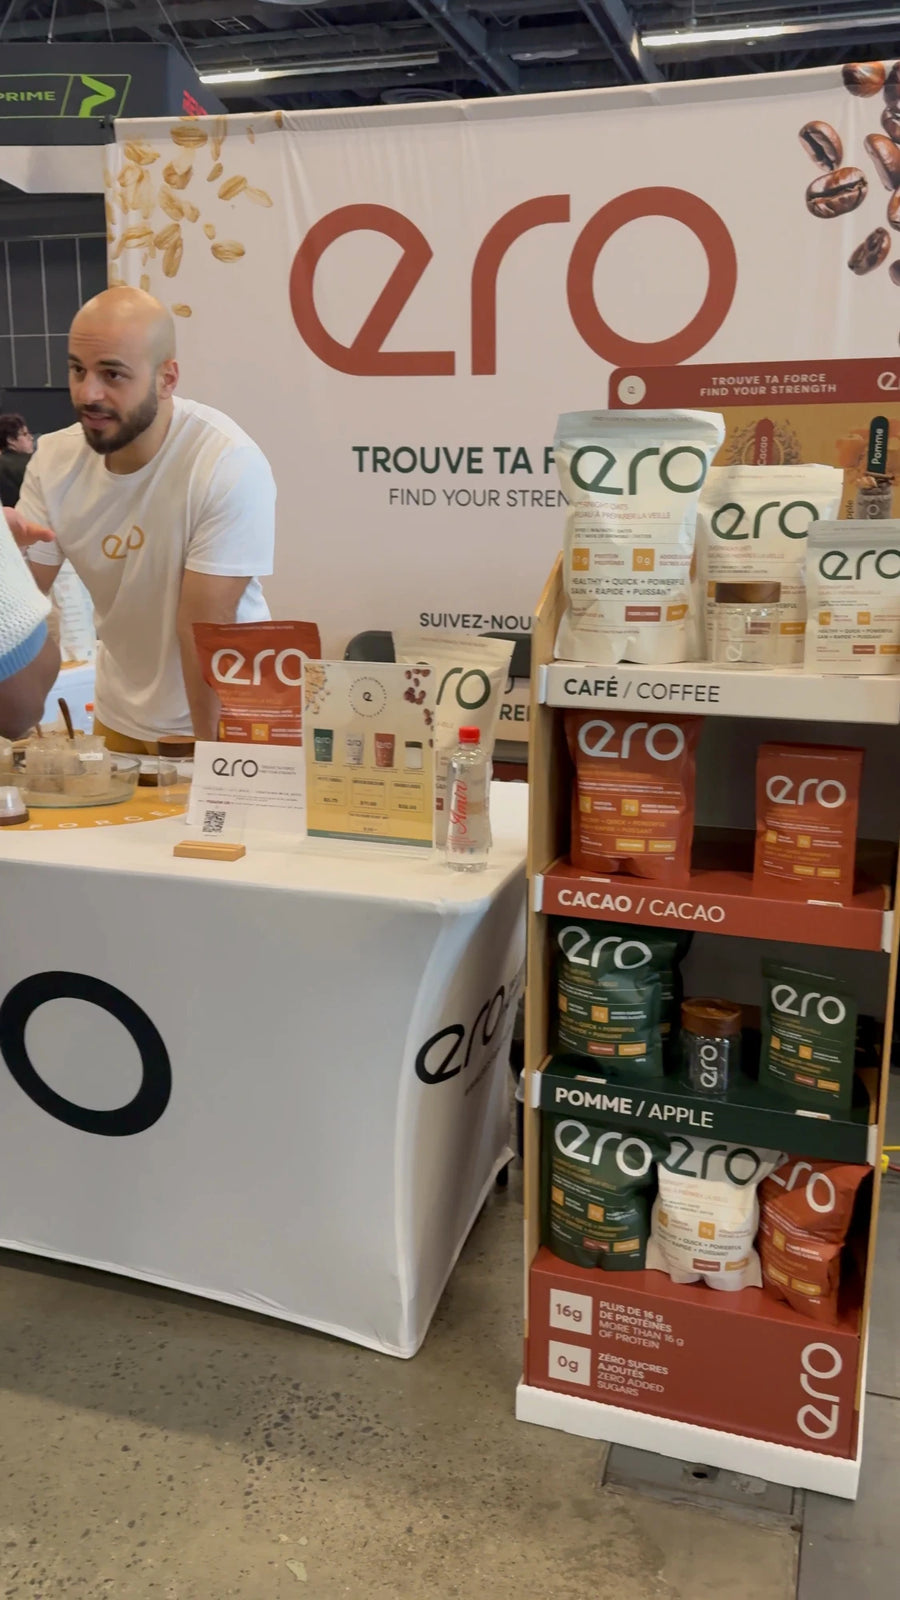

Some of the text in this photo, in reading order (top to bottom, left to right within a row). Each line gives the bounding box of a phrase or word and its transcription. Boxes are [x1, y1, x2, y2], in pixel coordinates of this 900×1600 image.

[289, 186, 738, 377] ero
[700, 384, 837, 397] FIND YOUR STRENGTH
[712, 373, 827, 386] TROUVE TA FORCE
[352, 446, 484, 475] TROUVE
[493, 446, 533, 474] TA
[871, 428, 885, 465] Pomme
[570, 445, 708, 496] ero
[389, 488, 436, 506] FIND
[442, 489, 500, 507] YOUR
[711, 500, 819, 540] ero
[819, 549, 900, 580] ero
[211, 648, 309, 687] ero
[436, 667, 492, 710] ro
[564, 676, 619, 698] CAFÉ
[636, 682, 721, 703] COFFEE
[578, 719, 685, 762] ero
[212, 758, 259, 778] ero
[766, 775, 847, 809] ero
[557, 889, 633, 913] CACAO
[649, 899, 726, 923] CACAO
[557, 925, 653, 970] ero
[771, 984, 847, 1025] ero
[415, 985, 505, 1085] ero
[700, 1045, 718, 1088] ero
[555, 1087, 633, 1115] POMME
[648, 1103, 714, 1129] APPLE
[554, 1119, 653, 1177] ero
[768, 1161, 836, 1214] ro
[555, 1303, 582, 1322] 16g
[600, 1301, 664, 1323] PLUS DE 16 g
[600, 1310, 614, 1320] DE
[599, 1321, 684, 1347] MORE THAN 16 g
[599, 1330, 660, 1350] OF PROTEIN
[557, 1355, 579, 1373] 0g
[628, 1359, 669, 1375] SUCRES
[597, 1371, 665, 1393] ZERO ADDED
[597, 1380, 640, 1397] SUGARS
[797, 1342, 843, 1440] ero
